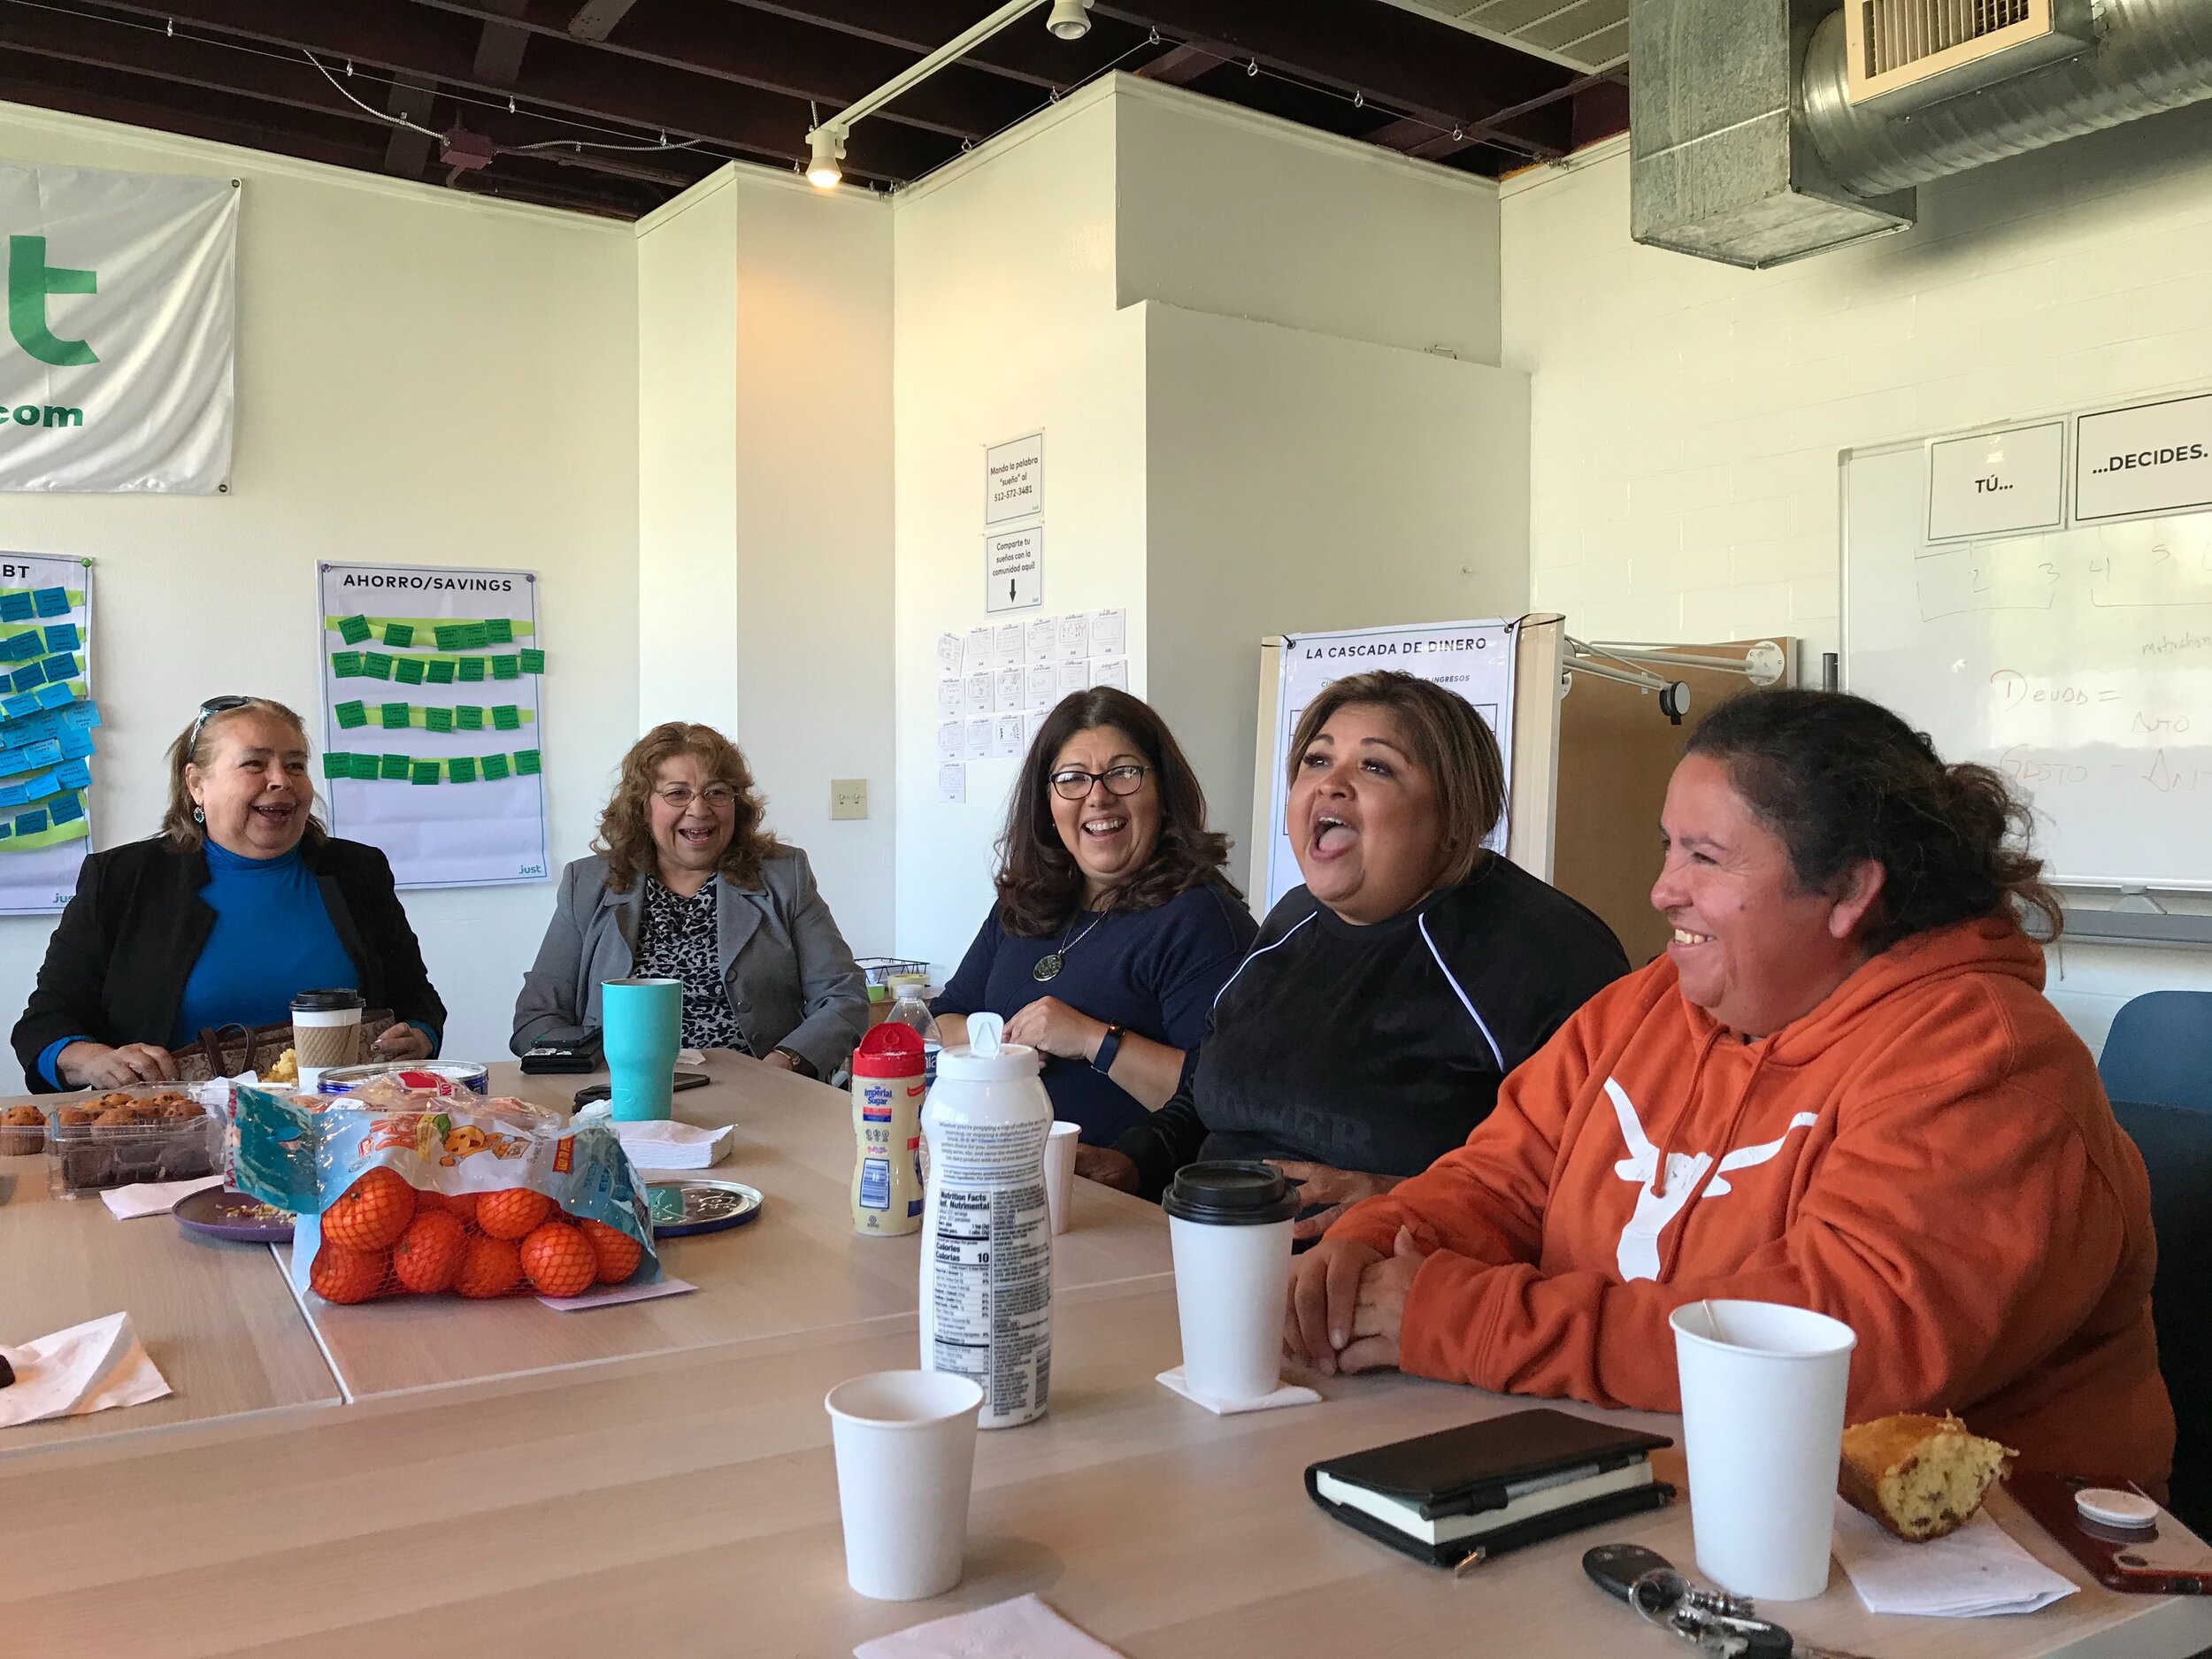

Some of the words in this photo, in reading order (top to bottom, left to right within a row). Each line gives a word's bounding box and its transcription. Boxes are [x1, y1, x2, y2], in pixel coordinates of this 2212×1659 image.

[990, 464, 1009, 475] Manda
[1016, 457, 1038, 471] palabra
[1022, 472, 1027, 480] al
[1975, 474, 2014, 494] TÚ...
[995, 485, 1033, 502] 512-572-3481
[996, 540, 1023, 550] Comparte
[996, 554, 1014, 564] sueños
[2037, 562, 2062, 585] 3
[2088, 557, 2111, 583] 4
[2152, 543, 2170, 565] 5
[992, 564, 1020, 576] comunidad
[343, 574, 512, 592] AHORRO/SAVINGS
[1306, 648, 1324, 659] LA
[1328, 643, 1397, 658] CASCADA
[1402, 641, 1422, 654] DE
[1428, 637, 1486, 652] DINERO
[1432, 674, 1471, 684] INGRESOS
[519, 864, 541, 874] just
[864, 1088, 893, 1098] Imperial
[868, 1096, 888, 1106] Sugar
[941, 1191, 965, 1201] Nutrition
[949, 1201, 990, 1210] Nutrimental
[936, 1241, 961, 1253] Calories
[978, 1253, 989, 1263] 10
